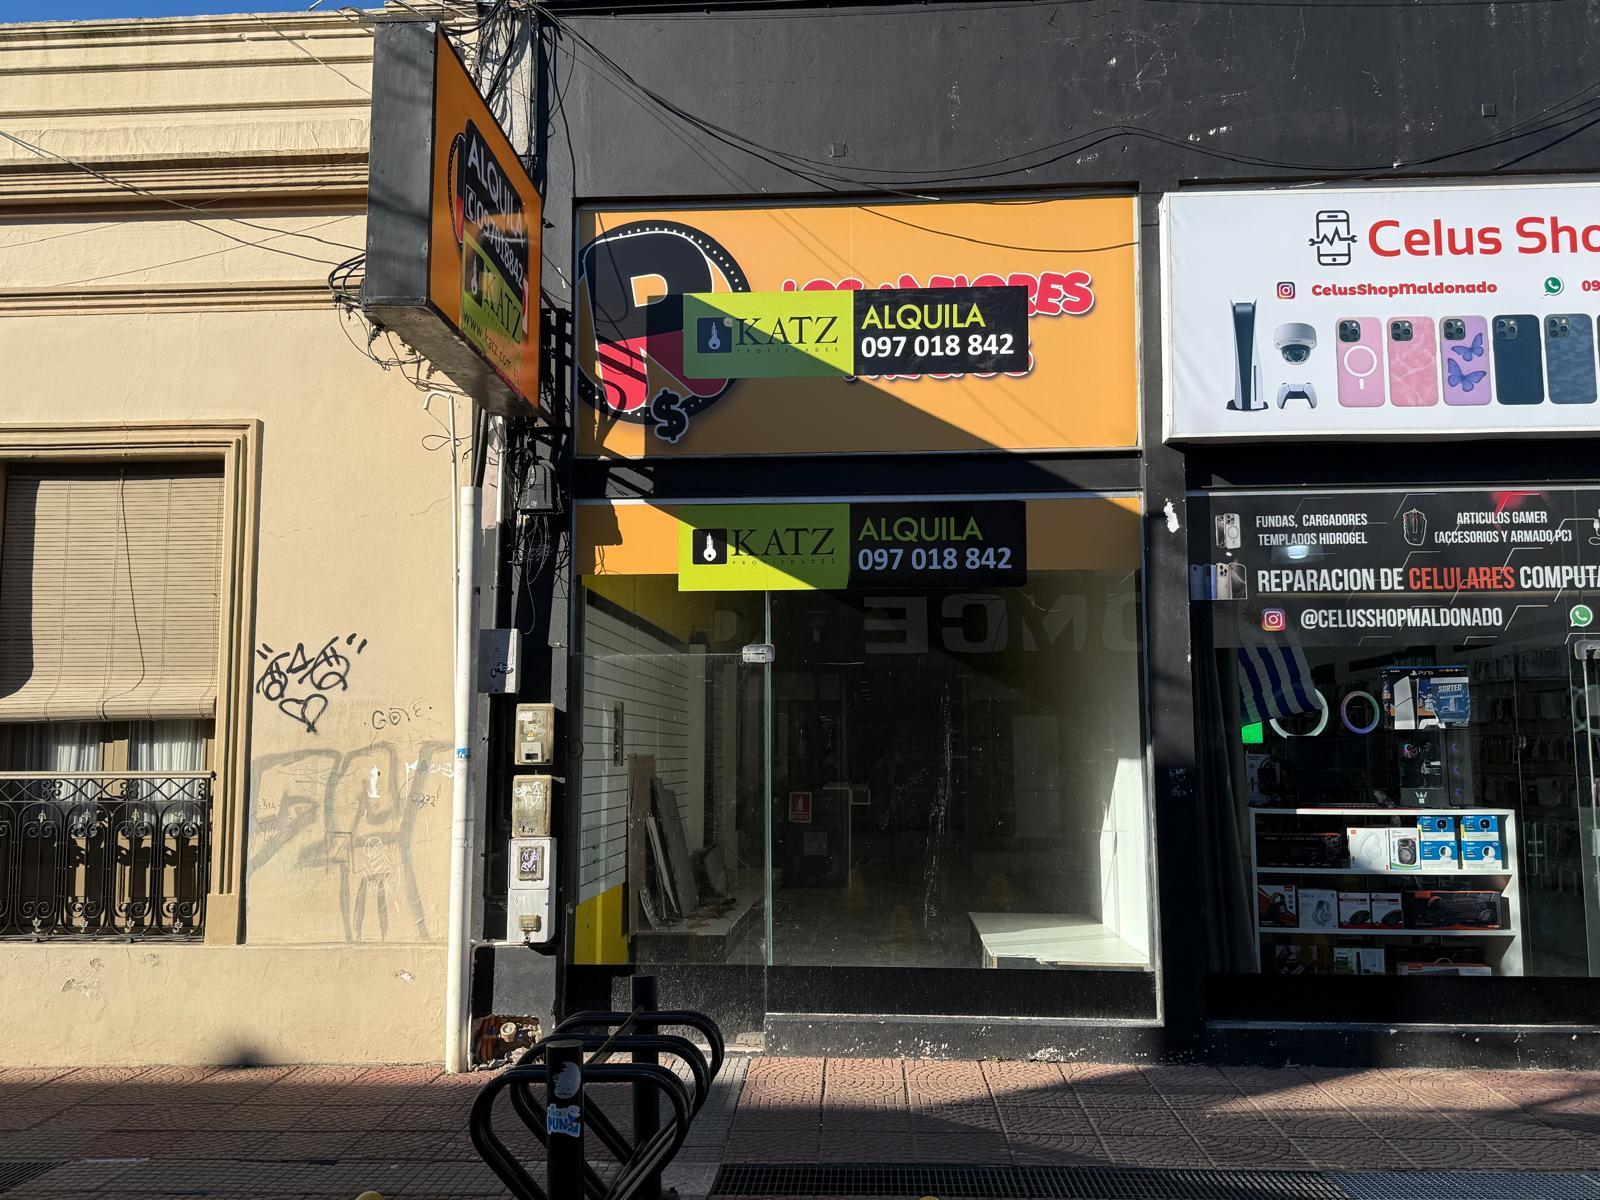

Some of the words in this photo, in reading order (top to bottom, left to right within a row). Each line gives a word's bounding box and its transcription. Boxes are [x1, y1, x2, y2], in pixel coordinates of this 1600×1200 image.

[468, 134, 524, 248] ALQUILA
[1368, 218, 1502, 257] Celus
[484, 264, 521, 345] KATZ
[861, 303, 986, 330] ALQUILA
[735, 316, 839, 345] KATZ
[861, 336, 907, 358] 097
[914, 335, 961, 357] 018
[967, 333, 1015, 356] 842
[858, 516, 984, 542] ALQUILA
[1255, 514, 1298, 530] FUNDAS,
[1302, 513, 1368, 527] CARGADORES
[1456, 511, 1510, 525] ARTICULOS
[1512, 511, 1548, 524] GAMER
[731, 528, 835, 556] KATZ
[1257, 533, 1317, 547] TEMPLADOS
[1319, 532, 1368, 546] HIDROGEL
[1500, 530, 1508, 543] Y
[1510, 530, 1553, 542] ARMADO
[858, 548, 904, 571] 097
[911, 548, 958, 570] 018
[965, 547, 1012, 569] 842
[1257, 568, 1376, 593] REPARACION
[1380, 568, 1404, 591] DE
[1408, 566, 1516, 591] CELULARES
[1519, 565, 1600, 589] COMPUT
[1300, 607, 1504, 630] @CELUSSHOPMALDONADO
